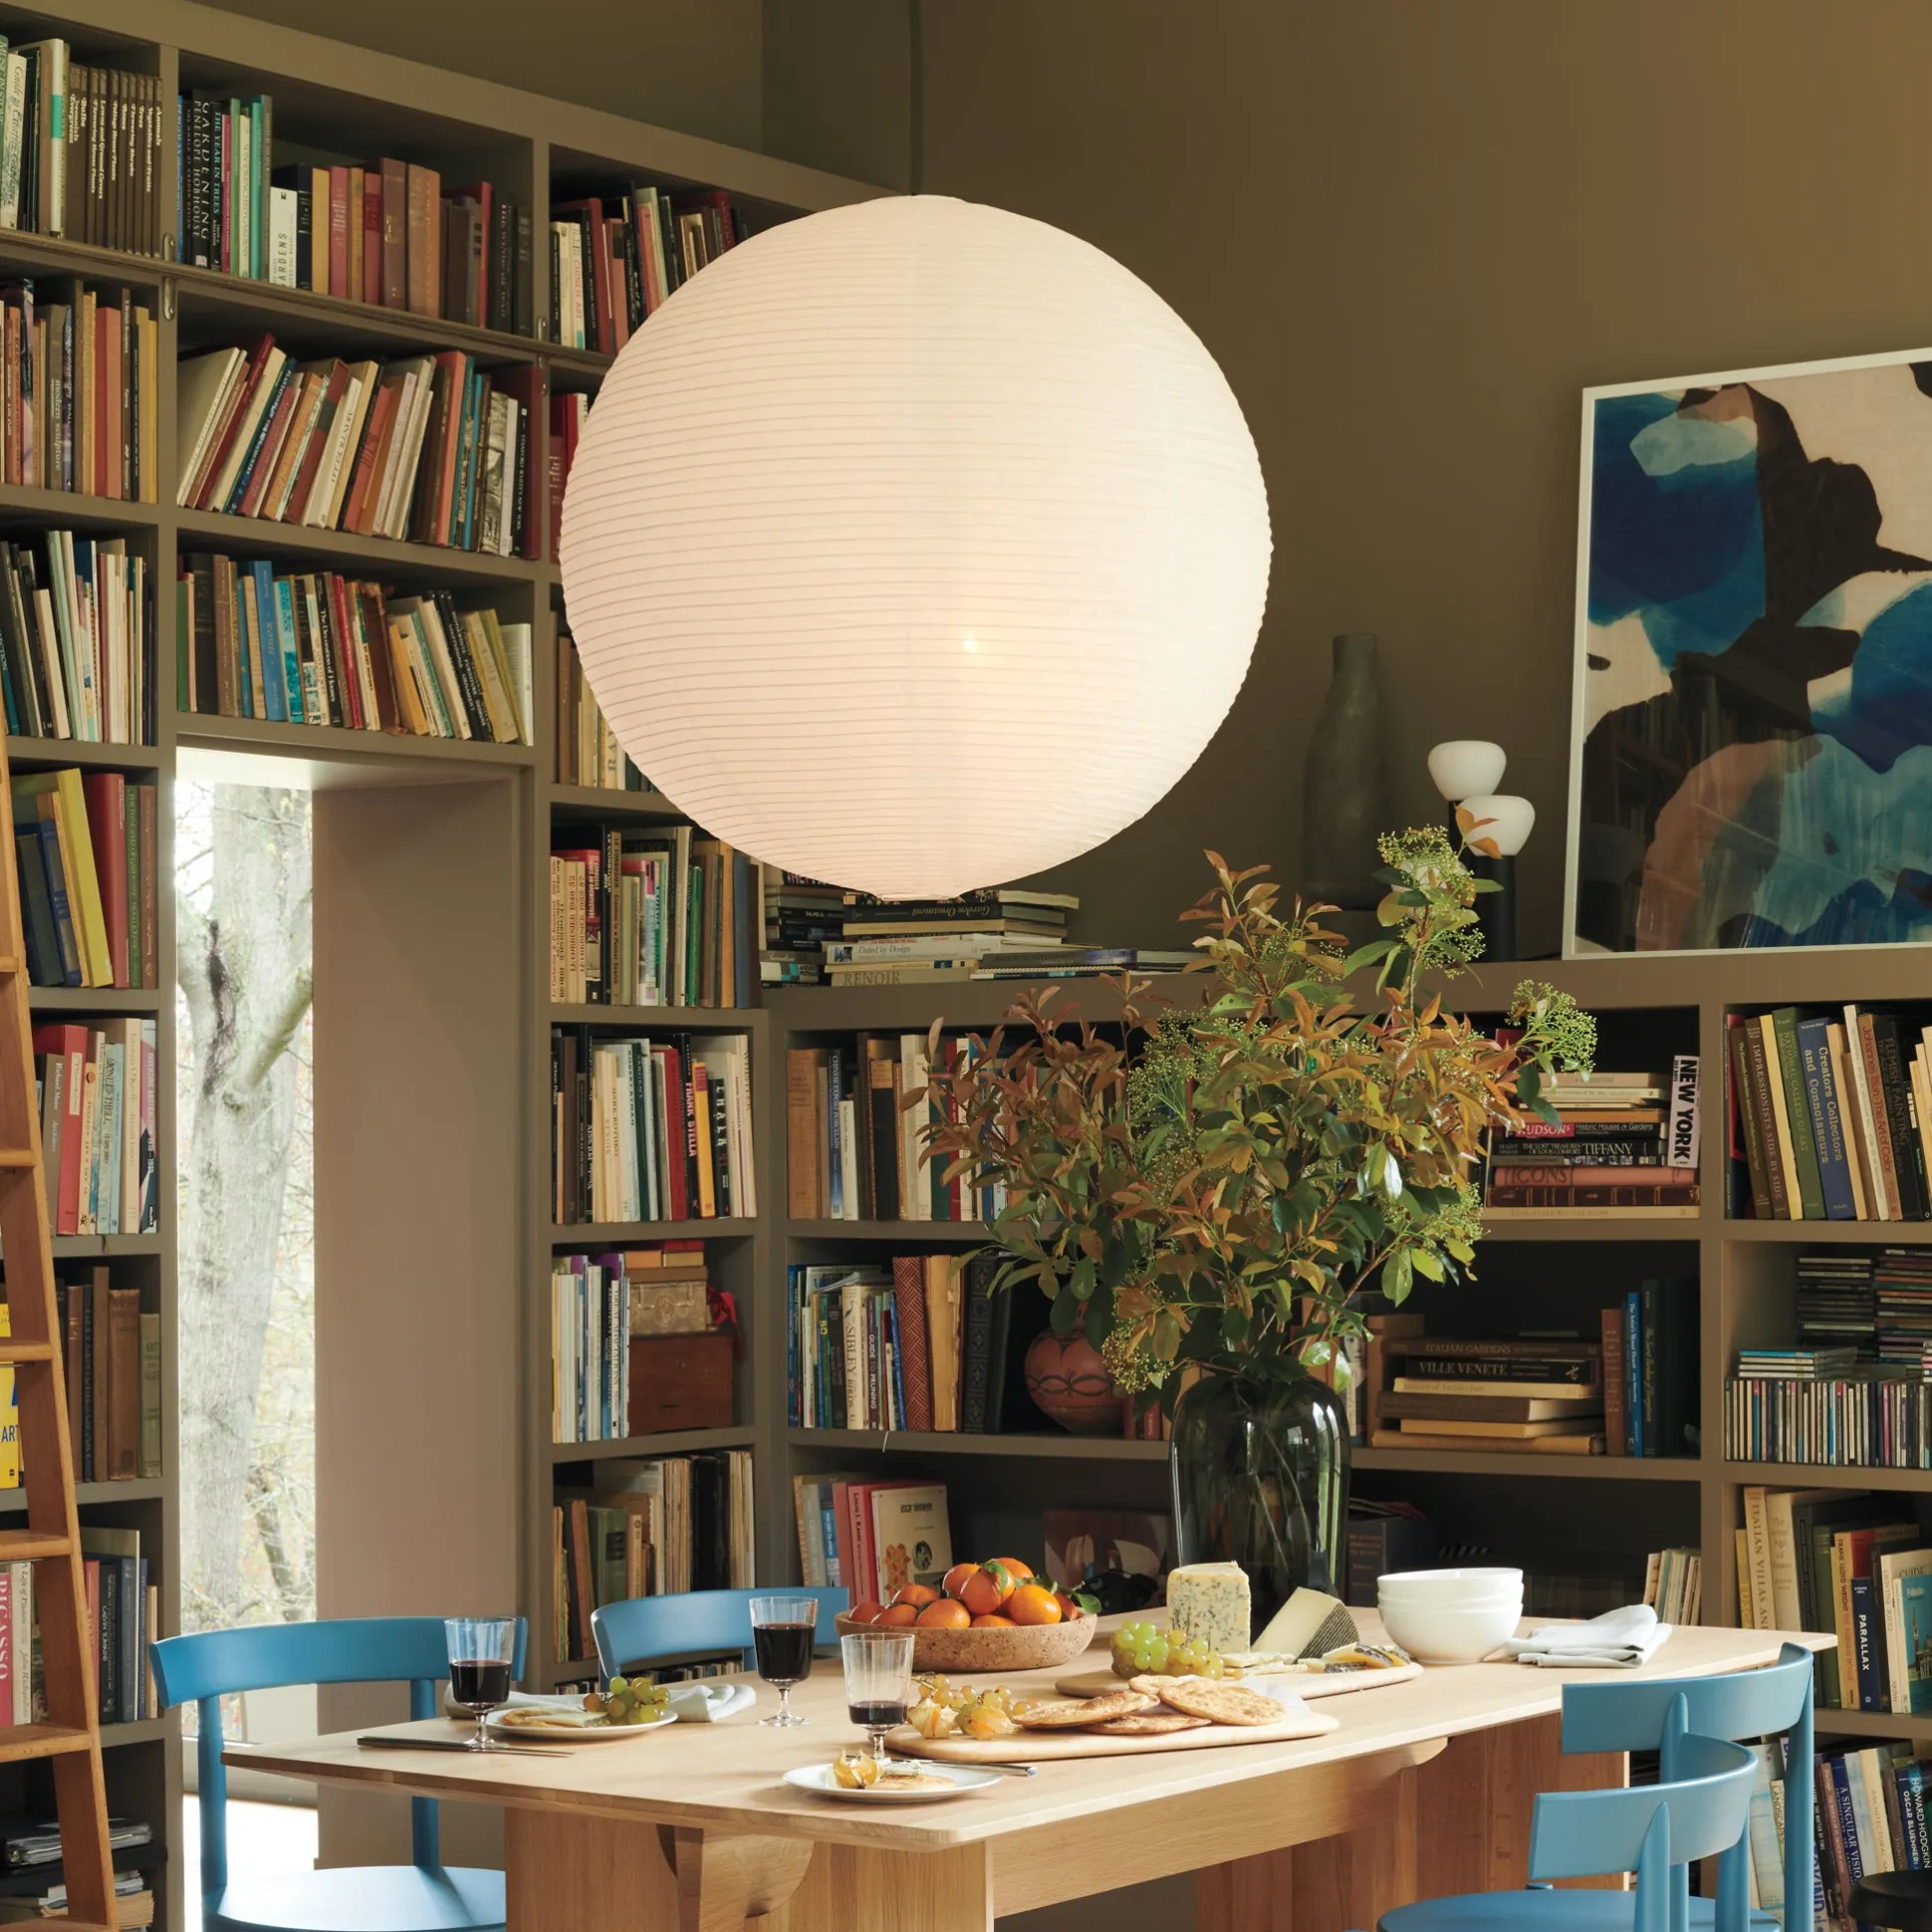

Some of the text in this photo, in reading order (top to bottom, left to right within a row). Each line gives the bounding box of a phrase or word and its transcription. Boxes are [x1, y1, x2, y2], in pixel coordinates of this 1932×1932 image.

[13, 66, 24, 96] Guide
[12, 98, 21, 110] to
[201, 102, 210, 239] GARDENING
[214, 167, 221, 179] IN
[192, 169, 201, 238] HOBHOUSE
[53, 423, 62, 471] sculpture
[319, 609, 328, 624] The
[326, 665, 334, 674] of
[463, 657, 478, 696] FURNITURE
[612, 837, 619, 847] LE
[912, 906, 991, 917] Garden Ornament
[879, 946, 887, 955] by
[889, 945, 911, 954] Design
[844, 970, 901, 986] RENOIR
[1861, 1025, 1878, 1075] Johannes
[1791, 1079, 1802, 1117] GALLERY
[1875, 1039, 1885, 1054] THE
[1888, 1116, 1898, 1134] AND
[1884, 1036, 1910, 1146] FLEMISH PAINTING
[1674, 1060, 1698, 1160] NEW YORK
[1803, 1048, 1830, 1163] and Connoisseurs
[1817, 1046, 1845, 1161] Creators Collectors
[1874, 1097, 1886, 1118] The
[684, 1082, 697, 1157] FRANK STELLA
[1752, 1043, 1782, 1200] IMPRESSIONISTS SIDE BY SIDE
[1796, 1119, 1805, 1131] OF
[1877, 1118, 1888, 1134] Art
[1581, 1142, 1634, 1155] TIFFANY
[1799, 1133, 1808, 1153] ART
[1880, 1134, 1890, 1146] of
[1881, 1144, 1895, 1173] Color
[1511, 1168, 1568, 1184] ICONS
[820, 1319, 828, 1335] 50
[845, 1325, 857, 1376] SIBLEY
[1425, 1342, 1511, 1354] ITALIAN GARDENS
[868, 1360, 875, 1372] TO
[1419, 1361, 1508, 1376] VILLE VENETE
[1751, 1502, 1764, 1555] ITALIAN
[1776, 1551, 1785, 1560] of
[1836, 1538, 1845, 1561] FRANK
[20, 1570, 29, 1587] Life
[1755, 1559, 1767, 1602] VILLAS
[1838, 1562, 1847, 1583] LLOYD
[1839, 1584, 1849, 1611] WRIGHT
[1857, 1613, 1869, 1671] PARALLAX
[20, 1649, 30, 1718] John Richardson
[1902, 1790, 1913, 1818] OSCAR
[1911, 1777, 1931, 1869] HOWARD HODGKIN
[1840, 1796, 1857, 1848] SINGULAR
[1849, 1849, 1862, 1880] VISIO
